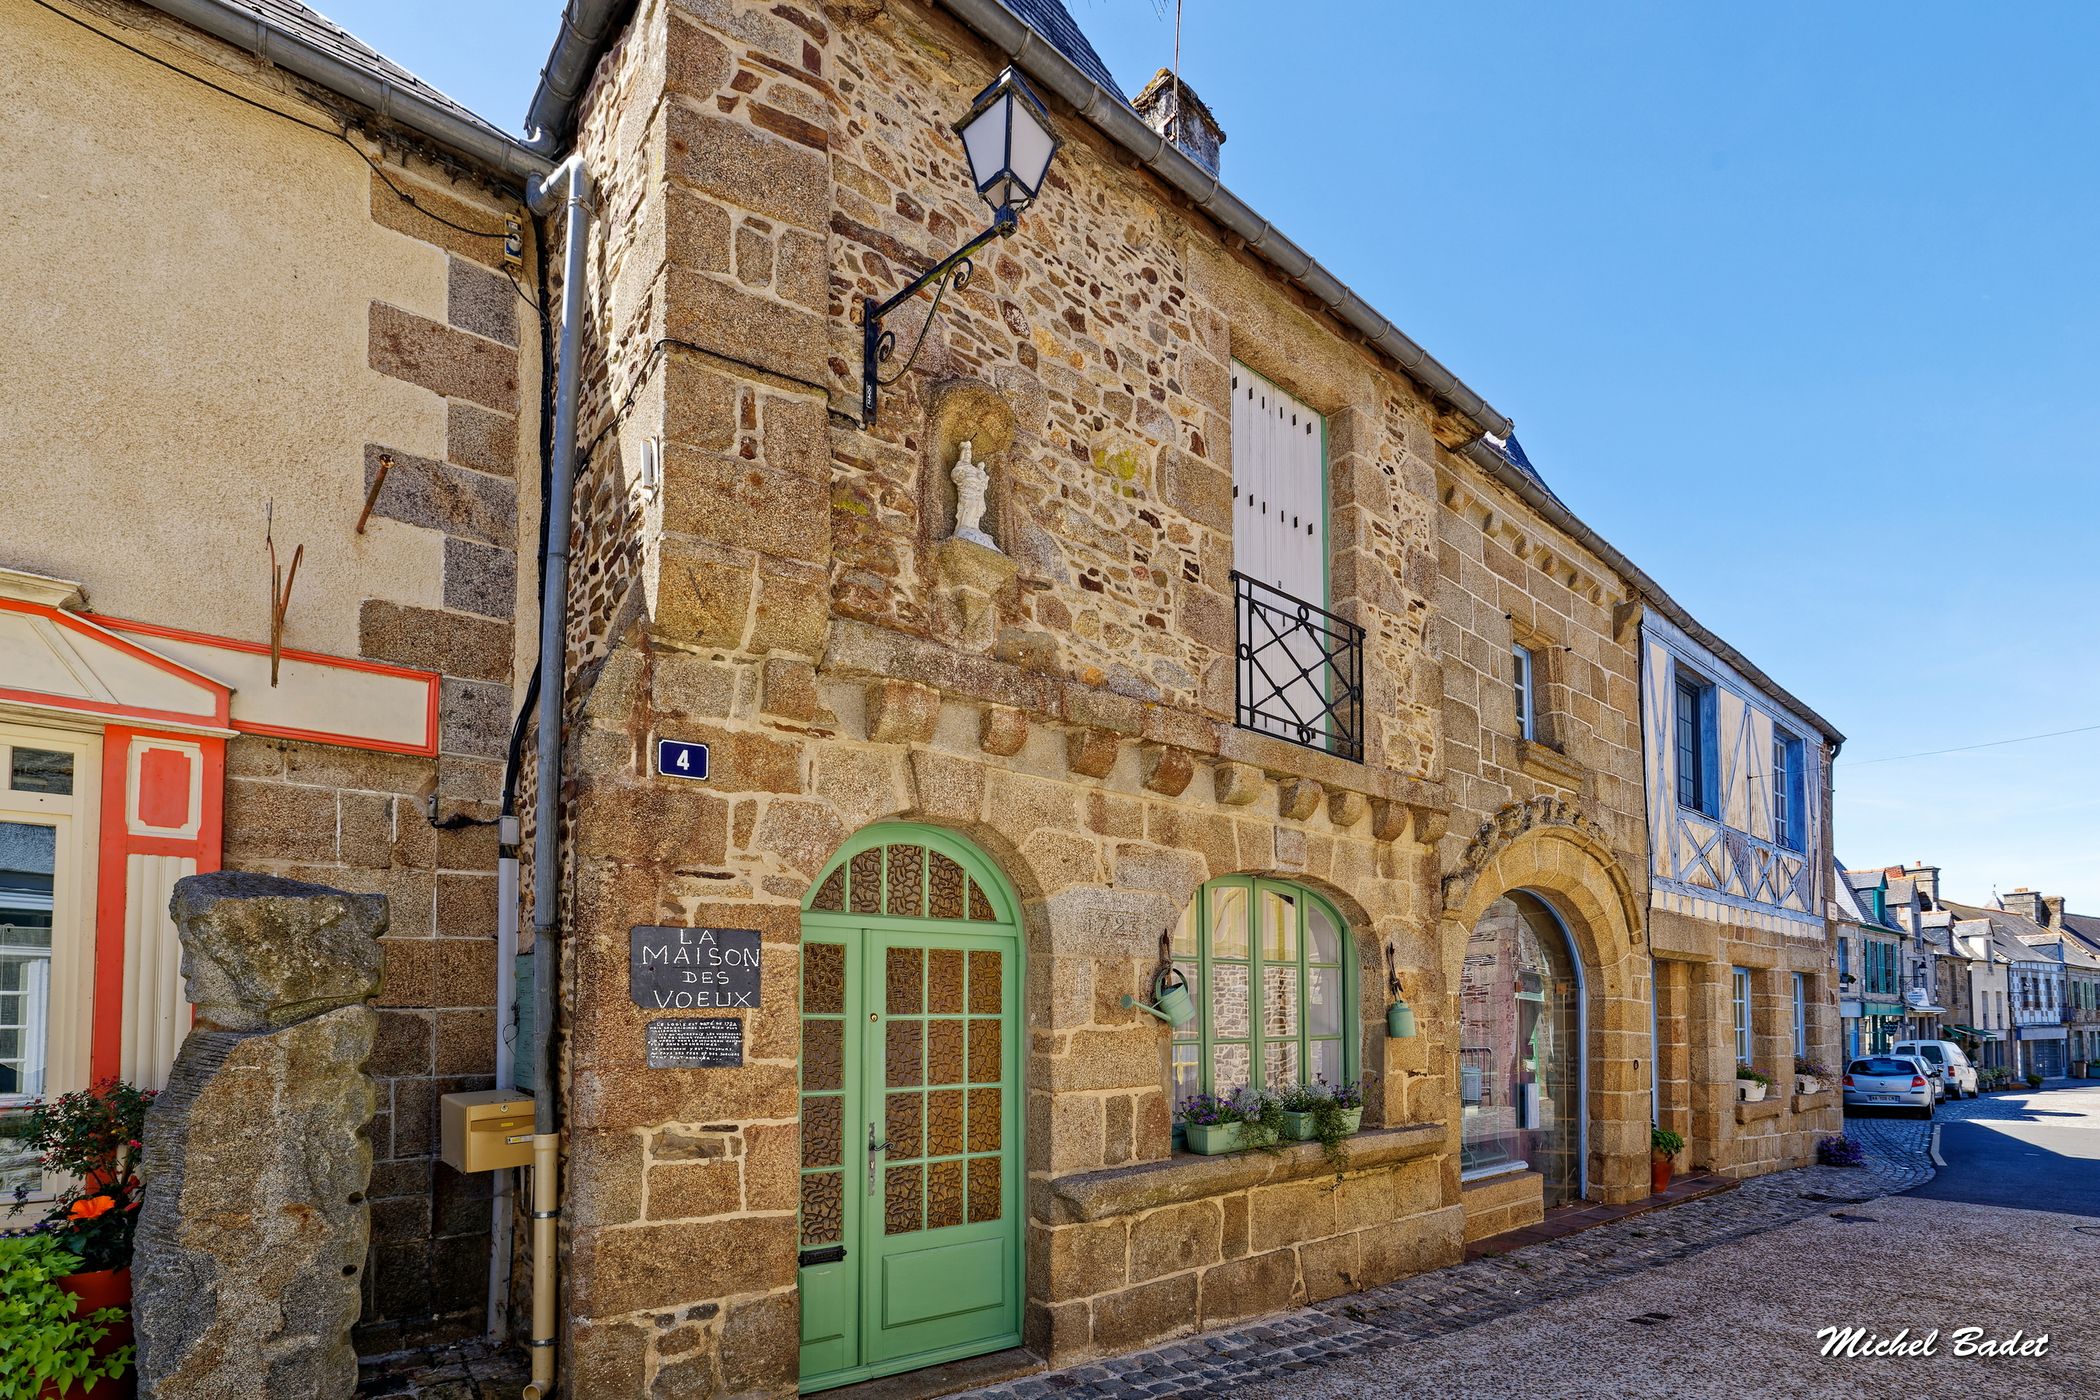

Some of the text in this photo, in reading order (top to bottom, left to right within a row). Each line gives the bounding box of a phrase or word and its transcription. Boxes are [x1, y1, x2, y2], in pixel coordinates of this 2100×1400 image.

[676, 749, 690, 770] 4
[680, 928, 717, 945] LA
[642, 945, 760, 967] MAISON
[682, 971, 730, 985] DES
[653, 990, 752, 1009] VOEUX
